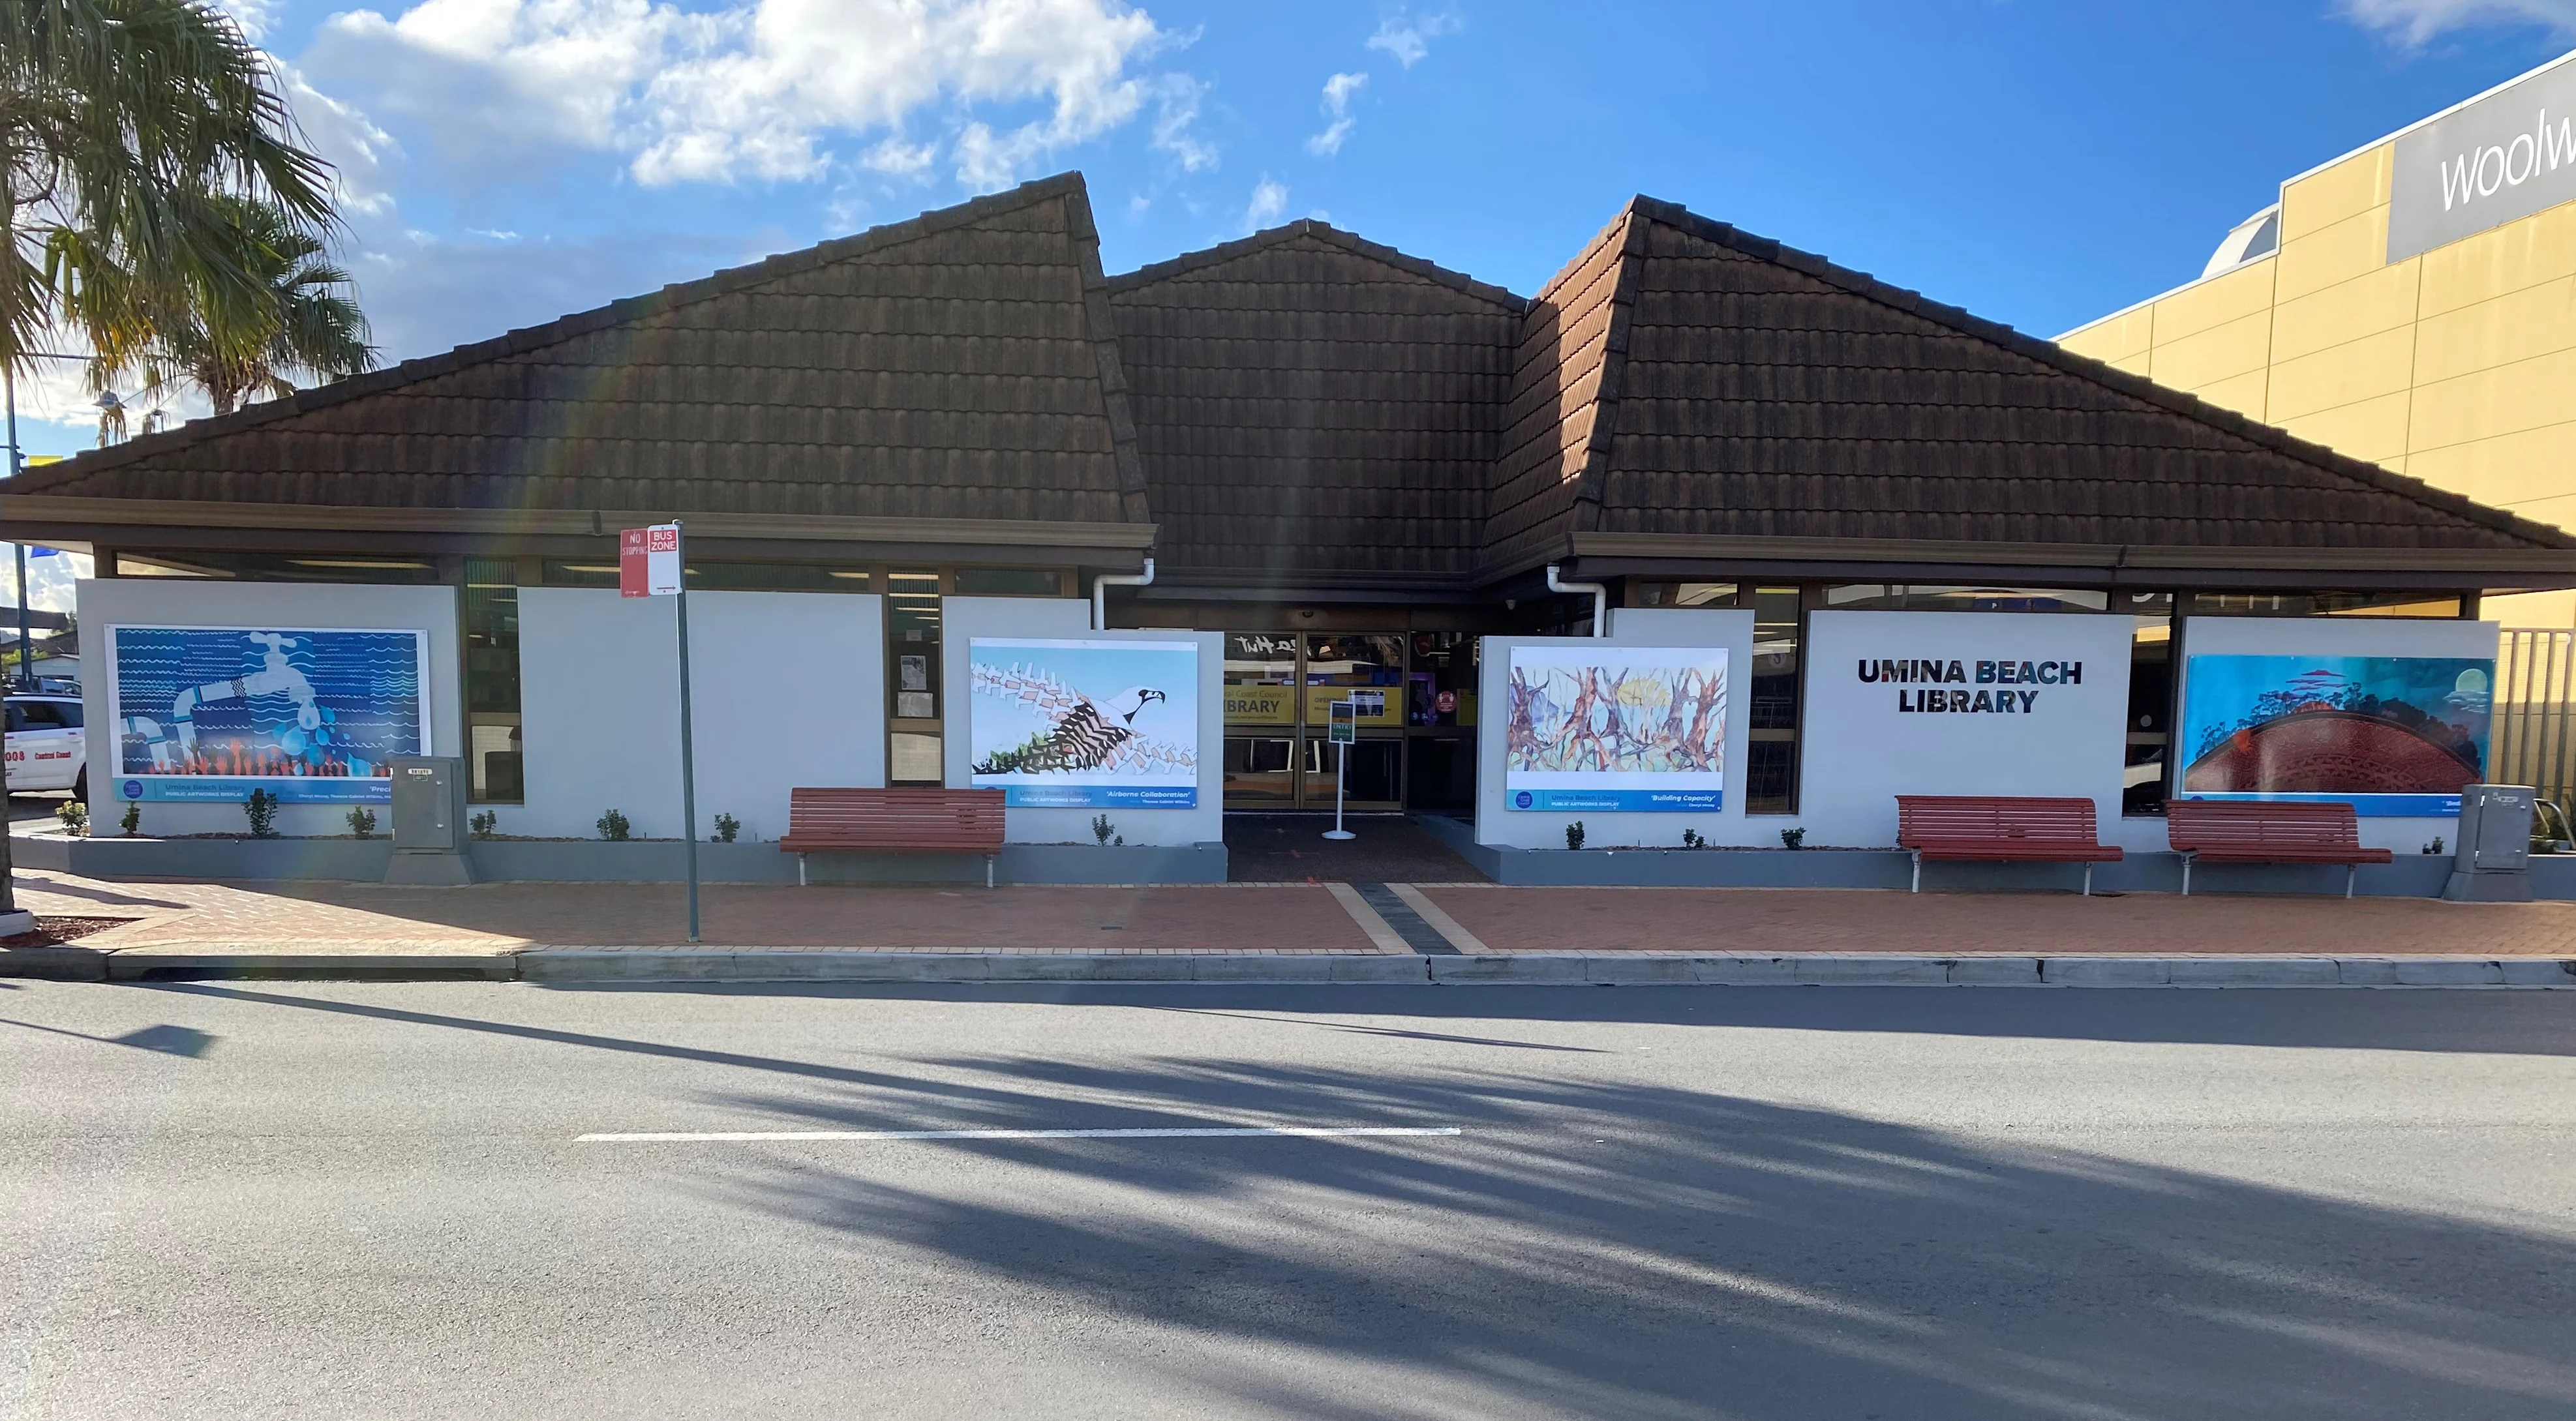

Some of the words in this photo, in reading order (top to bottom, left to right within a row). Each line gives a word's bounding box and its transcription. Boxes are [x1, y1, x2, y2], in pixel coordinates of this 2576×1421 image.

[629, 533, 641, 544] NO
[654, 531, 673, 541] BUS
[651, 541, 676, 551] ZONE
[1858, 659, 1967, 683] UMINA
[1975, 661, 2082, 685] BEACH
[1899, 689, 2040, 713] LIBRARY
